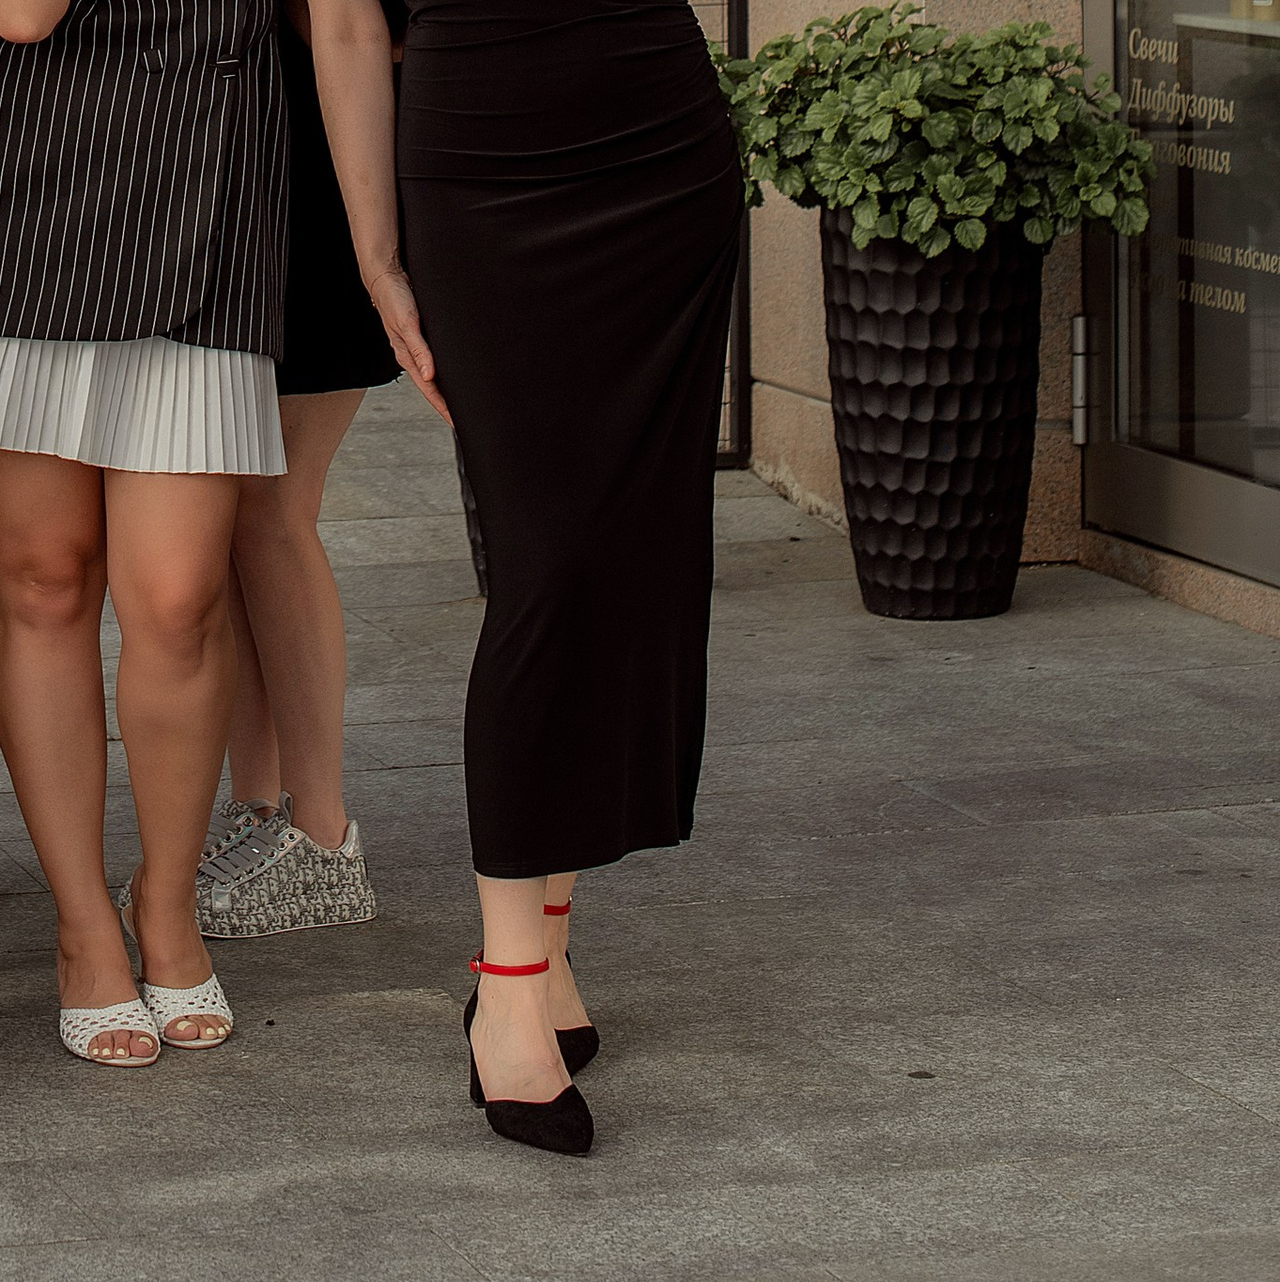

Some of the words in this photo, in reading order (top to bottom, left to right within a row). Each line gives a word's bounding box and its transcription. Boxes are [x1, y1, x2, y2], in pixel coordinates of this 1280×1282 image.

[1129, 27, 1180, 64] Свечи
[1127, 78, 1236, 130] Диффузоры
[1189, 281, 1247, 314] телом
